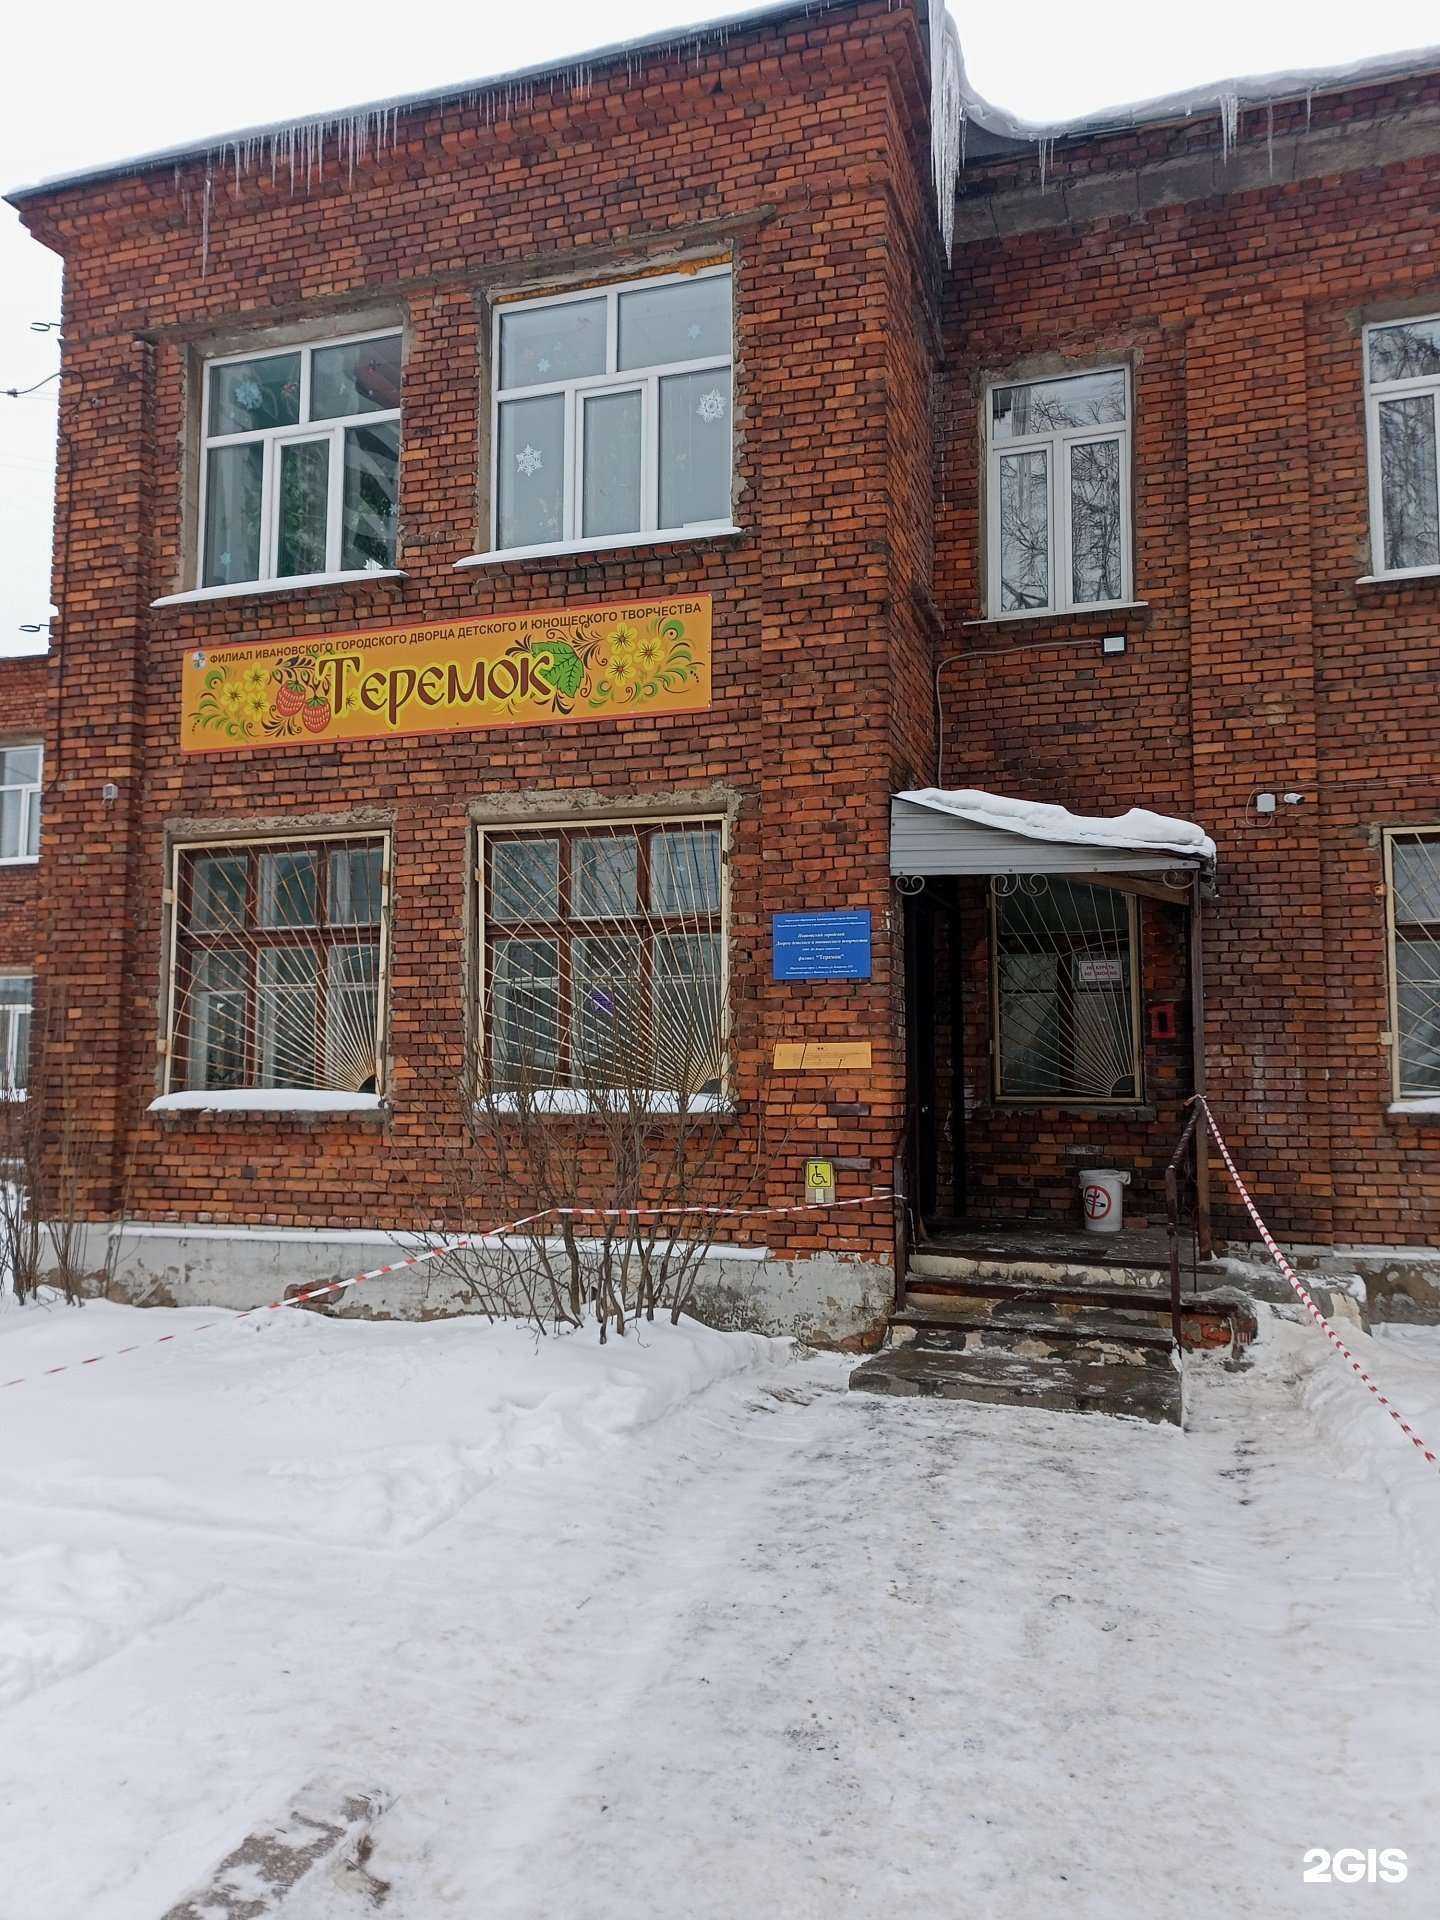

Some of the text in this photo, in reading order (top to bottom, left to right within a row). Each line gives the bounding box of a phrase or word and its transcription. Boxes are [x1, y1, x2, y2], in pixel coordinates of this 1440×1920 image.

[209, 651, 253, 665] ФИЛИАЛ
[255, 642, 333, 659] ИВАНОВСКОГО
[336, 635, 407, 651] ГОРОДСКОГО
[409, 629, 454, 645] ДВОРЦА
[457, 621, 517, 639] ДЕТСКОГО
[520, 620, 528, 630] И
[621, 603, 702, 620] ТВОРЧЕСТВА
